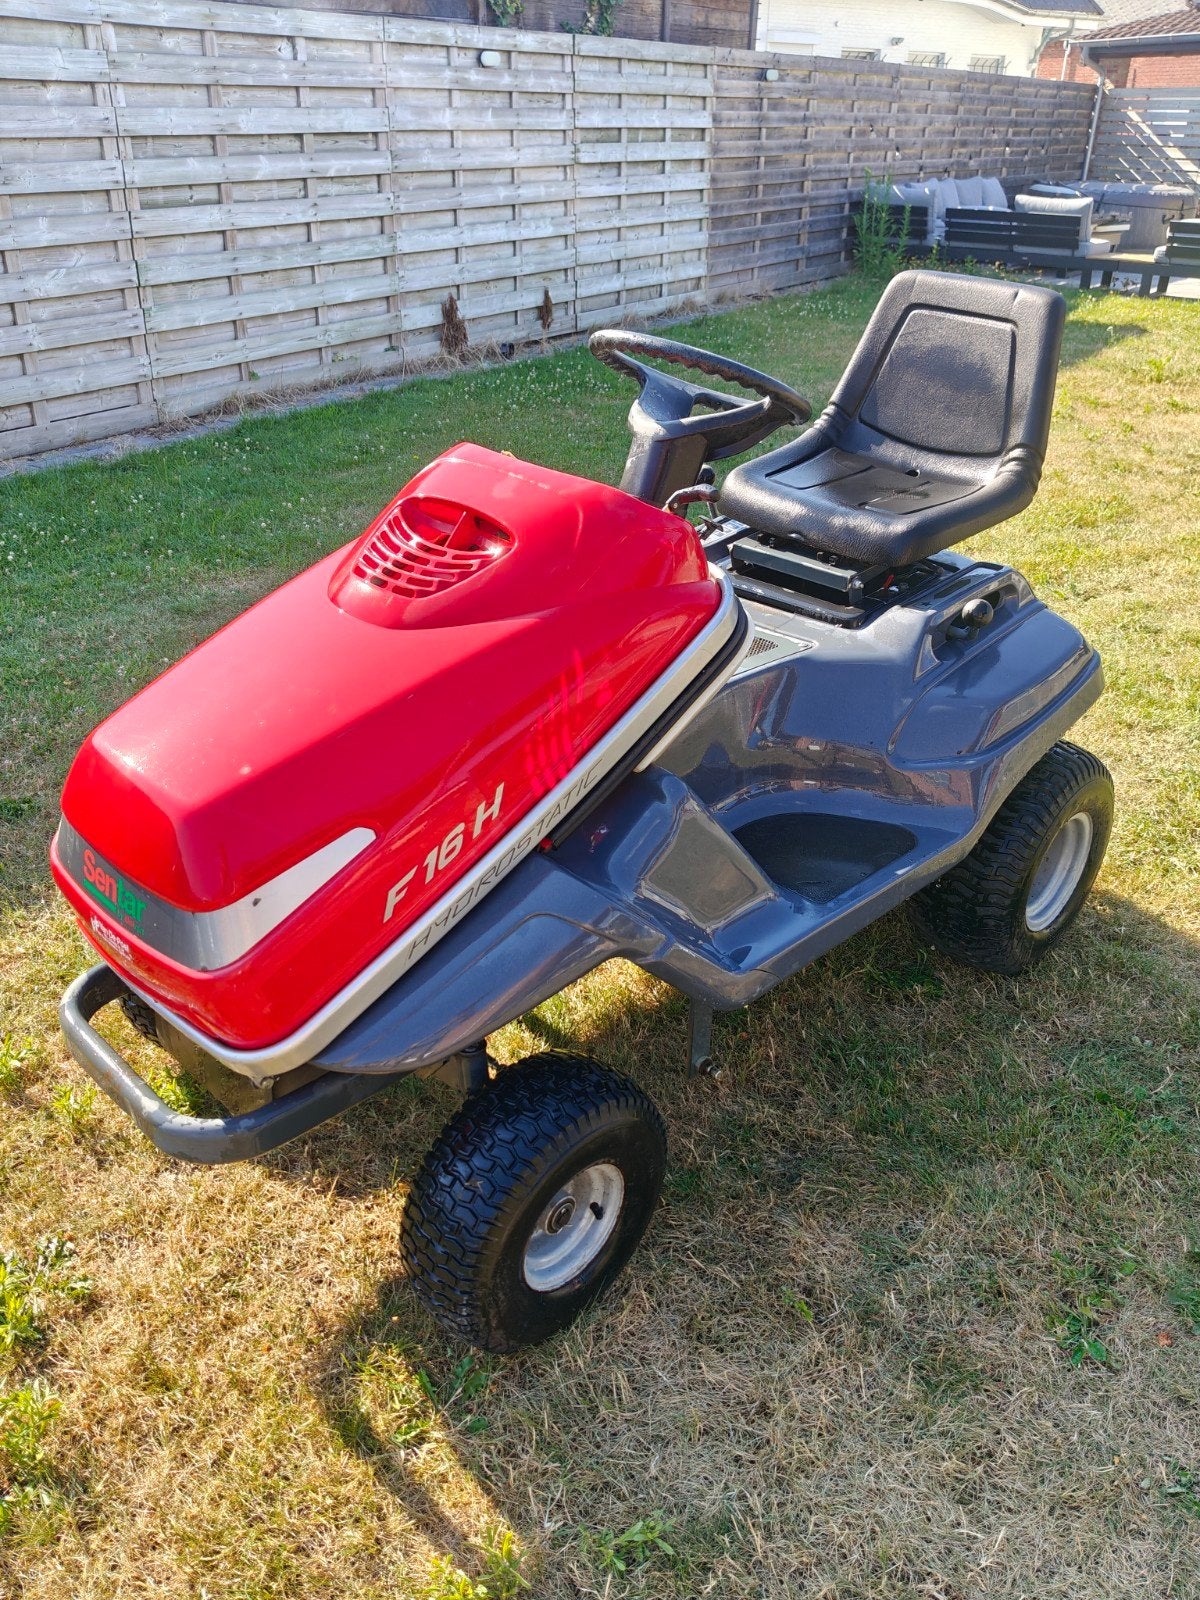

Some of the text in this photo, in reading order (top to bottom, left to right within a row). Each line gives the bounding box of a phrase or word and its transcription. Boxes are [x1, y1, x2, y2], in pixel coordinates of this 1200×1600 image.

[83, 849, 147, 921] Sentar
[383, 781, 505, 924] F 16 H
[408, 758, 603, 960] HYDROSTATIC
